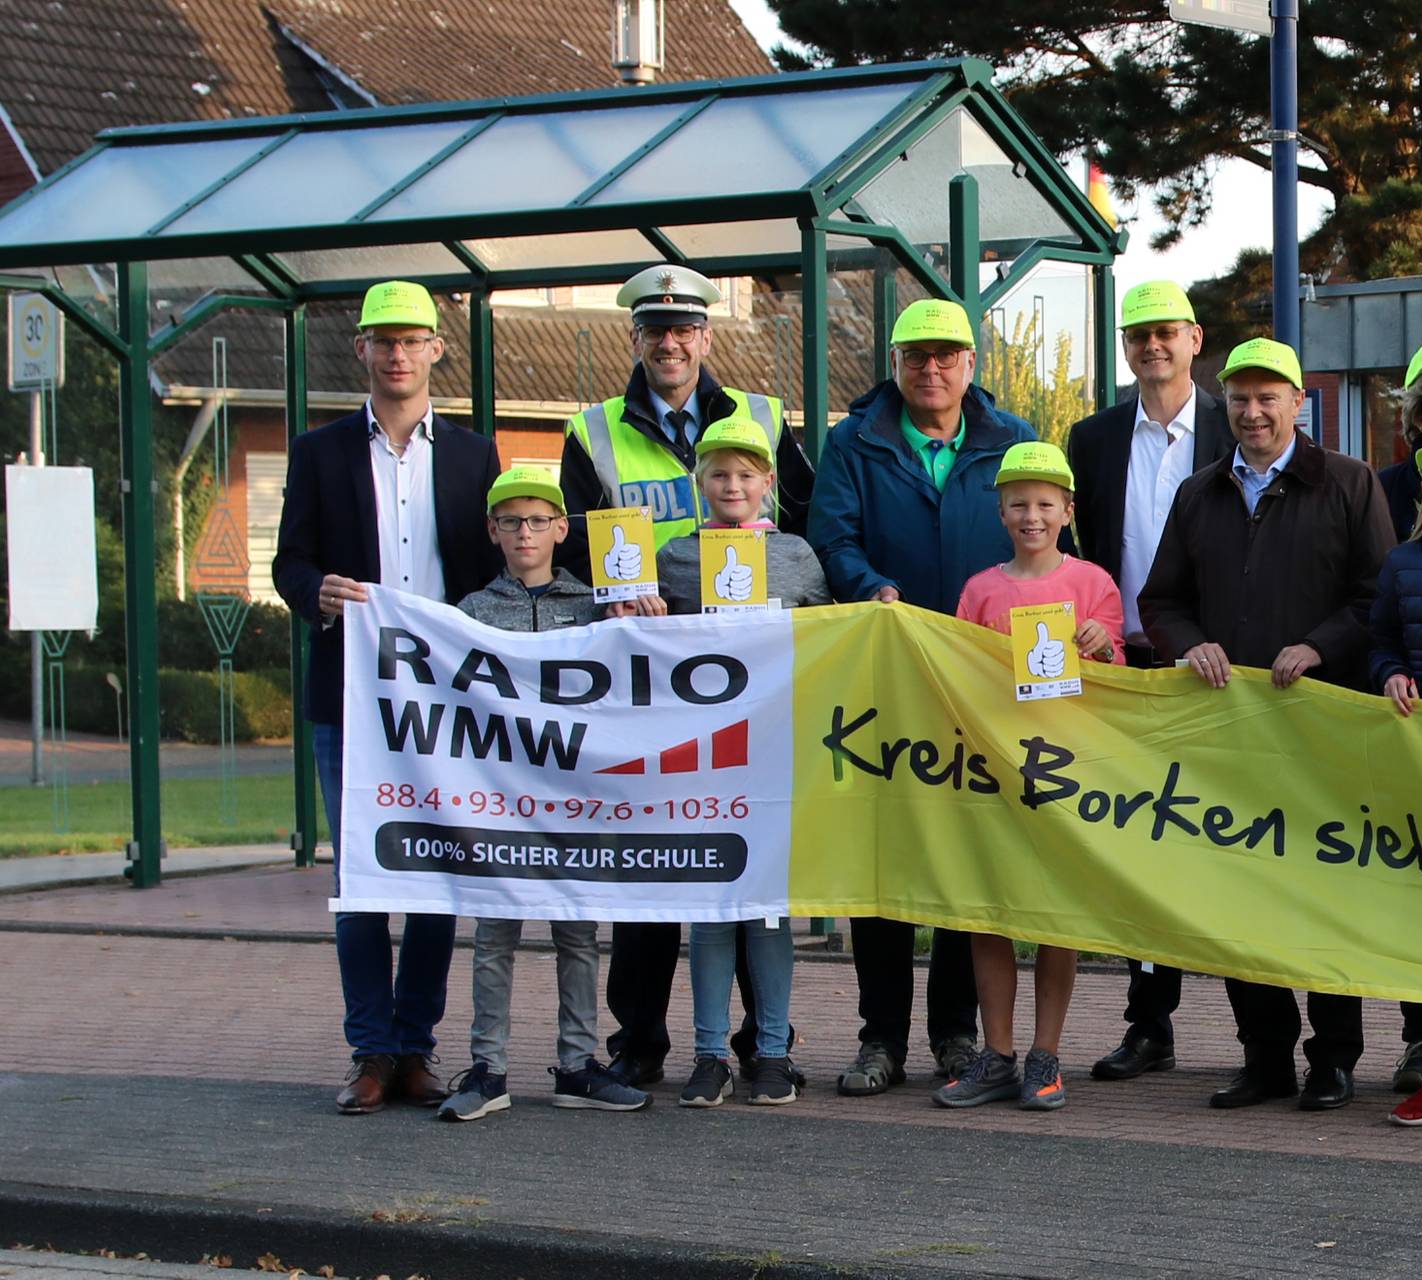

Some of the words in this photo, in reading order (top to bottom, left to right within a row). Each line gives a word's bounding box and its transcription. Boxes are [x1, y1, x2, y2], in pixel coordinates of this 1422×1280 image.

[26, 314, 44, 341] 30
[622, 481, 687, 520] POL
[377, 626, 749, 706] RADIO
[377, 697, 588, 771] WMW
[822, 706, 1000, 794] Kreis
[1019, 736, 1285, 857] Borken
[376, 783, 441, 811] 88.4
[469, 790, 536, 819] 93.0
[565, 798, 633, 820] 97.6
[664, 795, 749, 820] 103.6
[401, 838, 465, 861] 100%
[472, 843, 558, 866] SICHER
[564, 848, 615, 868] ZUR
[622, 848, 725, 868] SCHULE.
